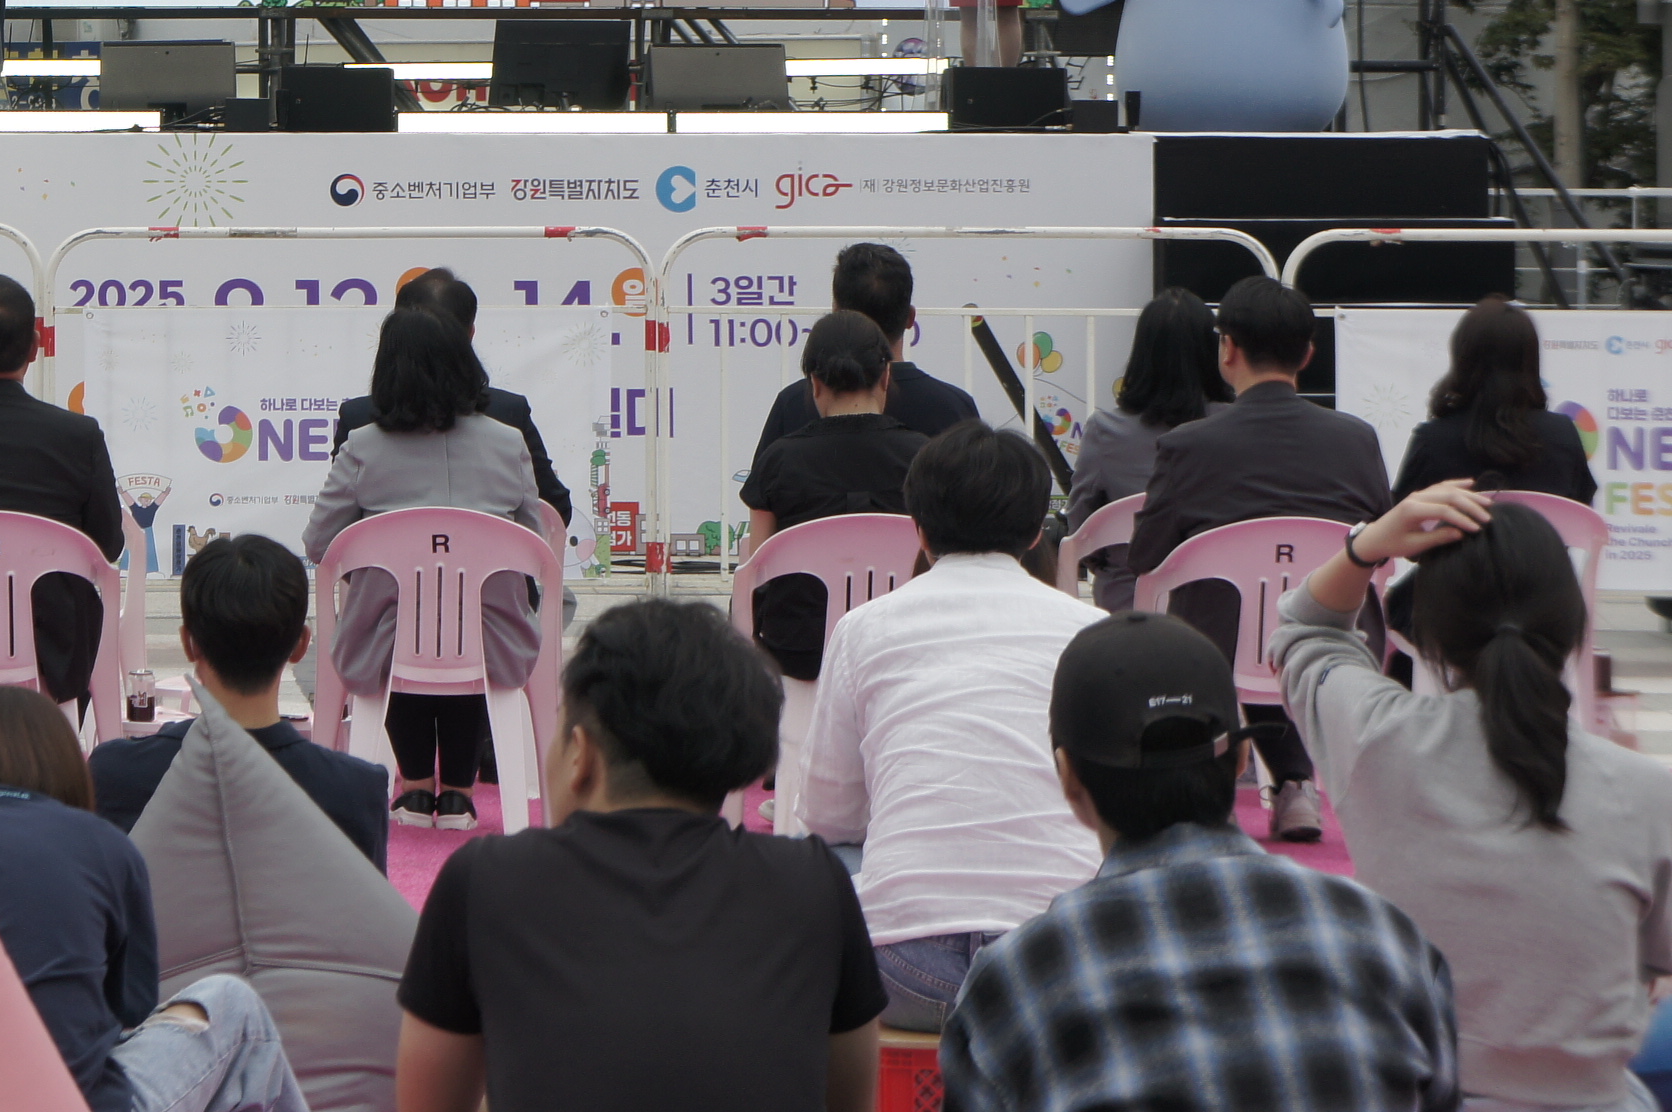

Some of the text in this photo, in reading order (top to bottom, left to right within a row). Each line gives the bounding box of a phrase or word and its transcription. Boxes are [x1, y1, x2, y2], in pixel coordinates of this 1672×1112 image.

[372, 180, 496, 201] 중소벤처기업부
[510, 177, 640, 202] 강원특별자치도
[704, 177, 759, 199] 춘천시
[882, 178, 1031, 194] 강원정보문화산업진흥원
[710, 274, 797, 306] 3일간
[260, 398, 338, 412] 하나로 다보는
[128, 476, 161, 488] FESTA
[1604, 481, 1672, 517] FES
[430, 533, 451, 554] R
[1275, 543, 1294, 563] R
